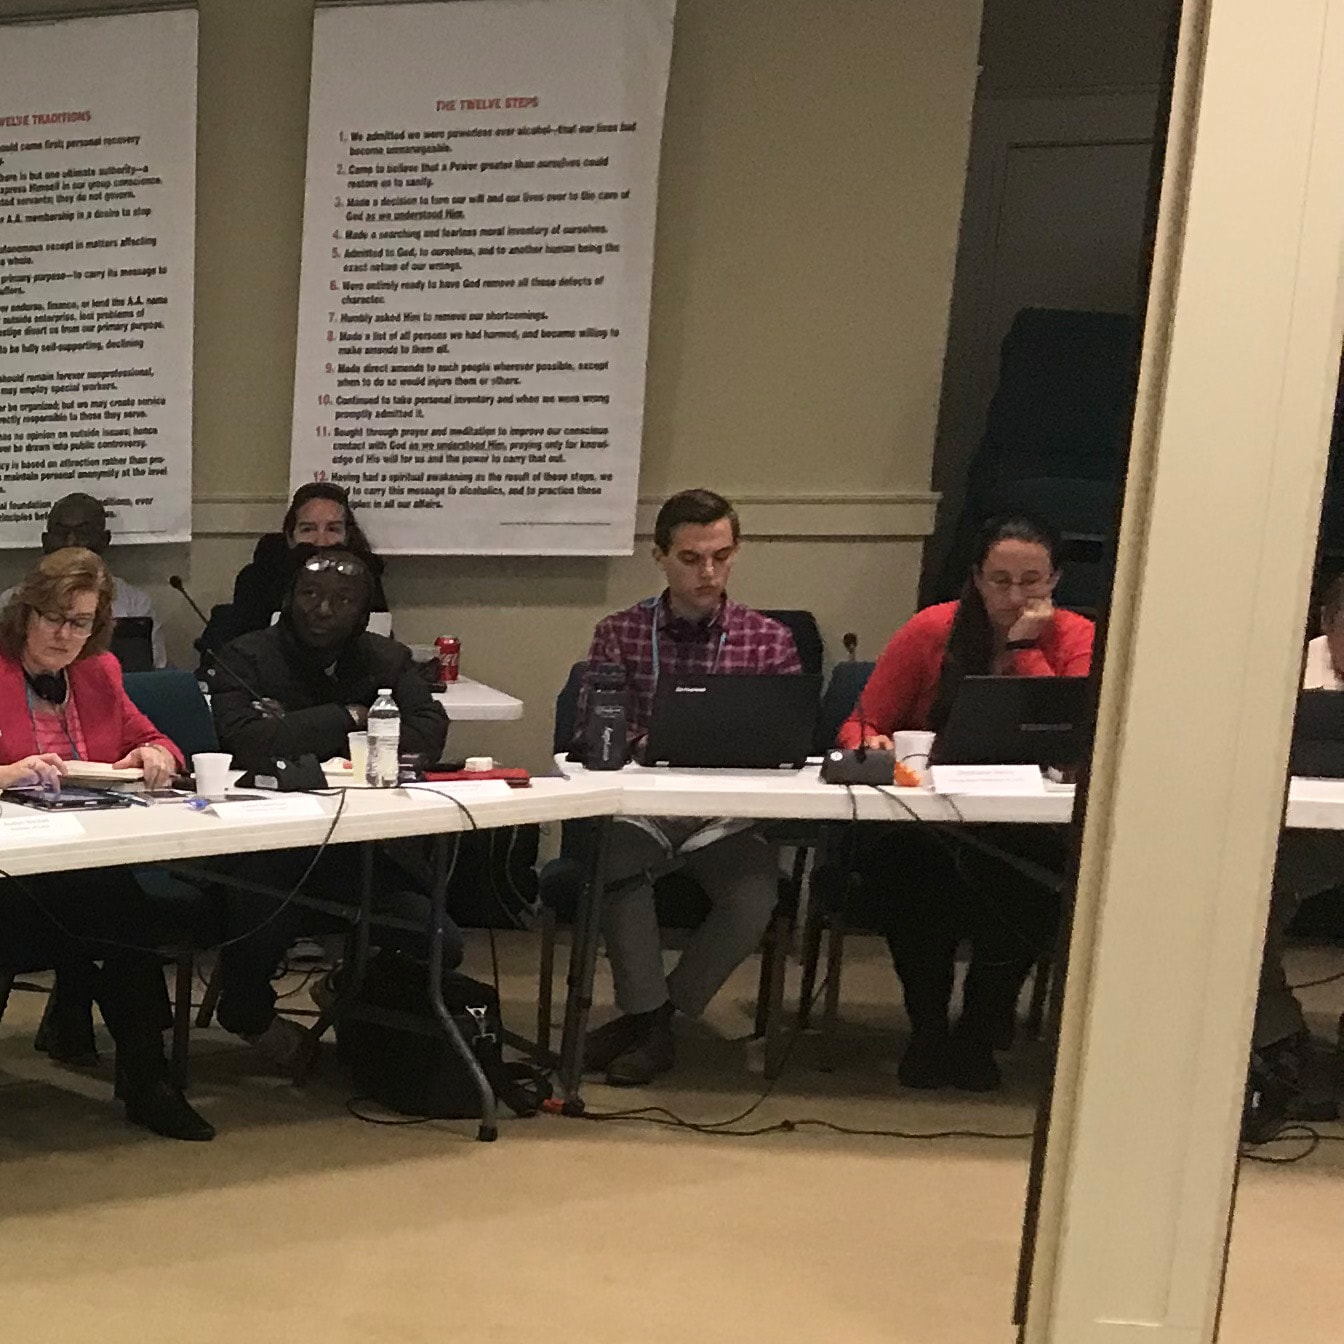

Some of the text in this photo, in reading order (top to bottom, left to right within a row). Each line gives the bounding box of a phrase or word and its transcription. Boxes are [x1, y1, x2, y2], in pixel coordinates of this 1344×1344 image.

[436, 97, 539, 111] THE TWELVE STEPS
[33, 112, 91, 126] TRADITIONS
